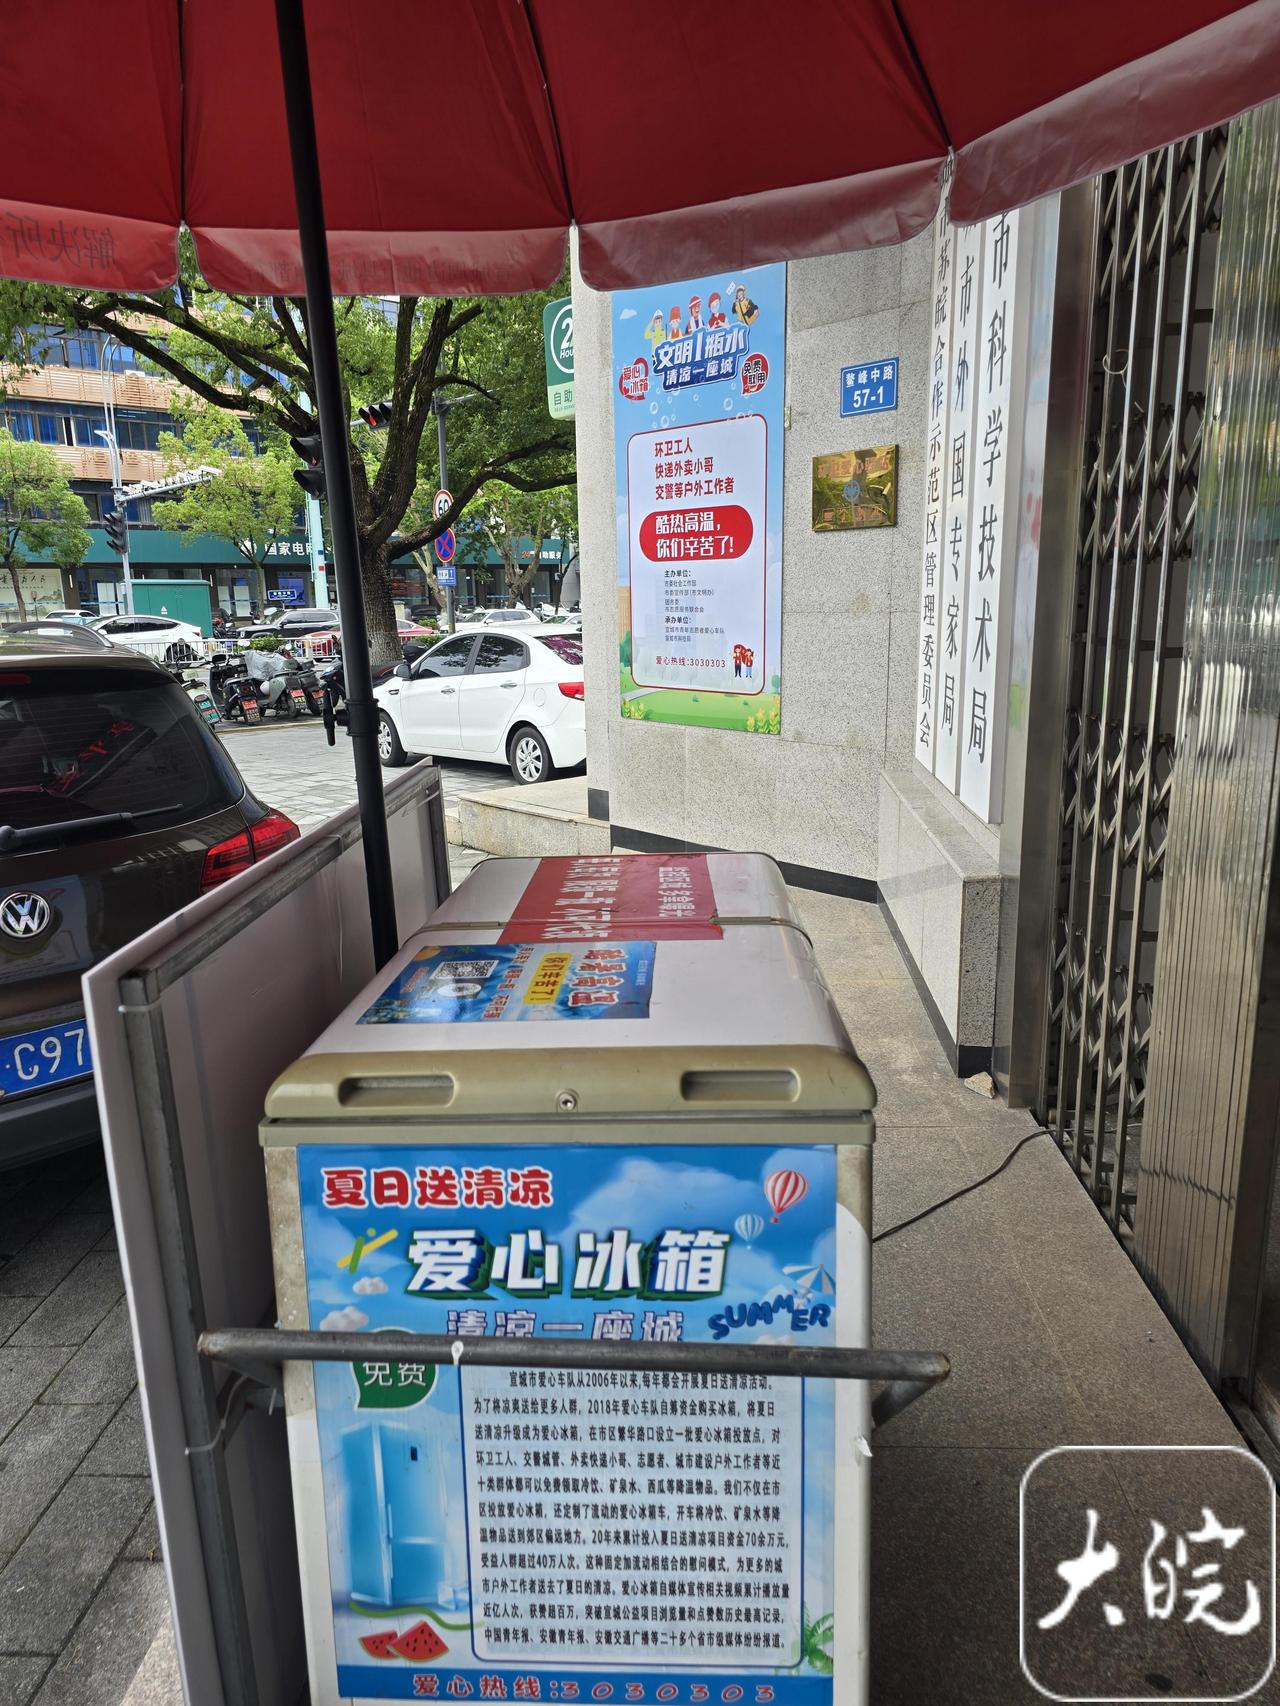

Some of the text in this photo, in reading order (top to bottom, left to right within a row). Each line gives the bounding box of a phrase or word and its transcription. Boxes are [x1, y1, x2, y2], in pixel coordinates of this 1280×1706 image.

[560, 317, 573, 350] 2
[623, 366, 641, 382] 爱心
[666, 357, 734, 386] 清凉一座城
[743, 360, 761, 376] 免费
[748, 372, 766, 386] 取用
[845, 365, 894, 388] 鳌峰中路
[554, 388, 573, 406] 自助
[630, 378, 649, 394] 冰箱
[853, 385, 884, 409] 57-1
[655, 437, 693, 458] 环卫工人
[655, 457, 714, 479] 快递外卖小哥
[941, 223, 976, 737] 市外国专家局
[655, 477, 735, 500] 交警等户外工作者
[656, 535, 734, 559] 你们辛苦了!
[322, 1167, 553, 1208] 夏日送清凉
[406, 1227, 731, 1295] 爱心冰箱
[446, 1308, 684, 1342] 清凉一座城
[708, 1293, 832, 1341] SUMMER
[362, 1361, 427, 1387] 免费
[413, 1673, 774, 1701] 爱心热线:3030303
